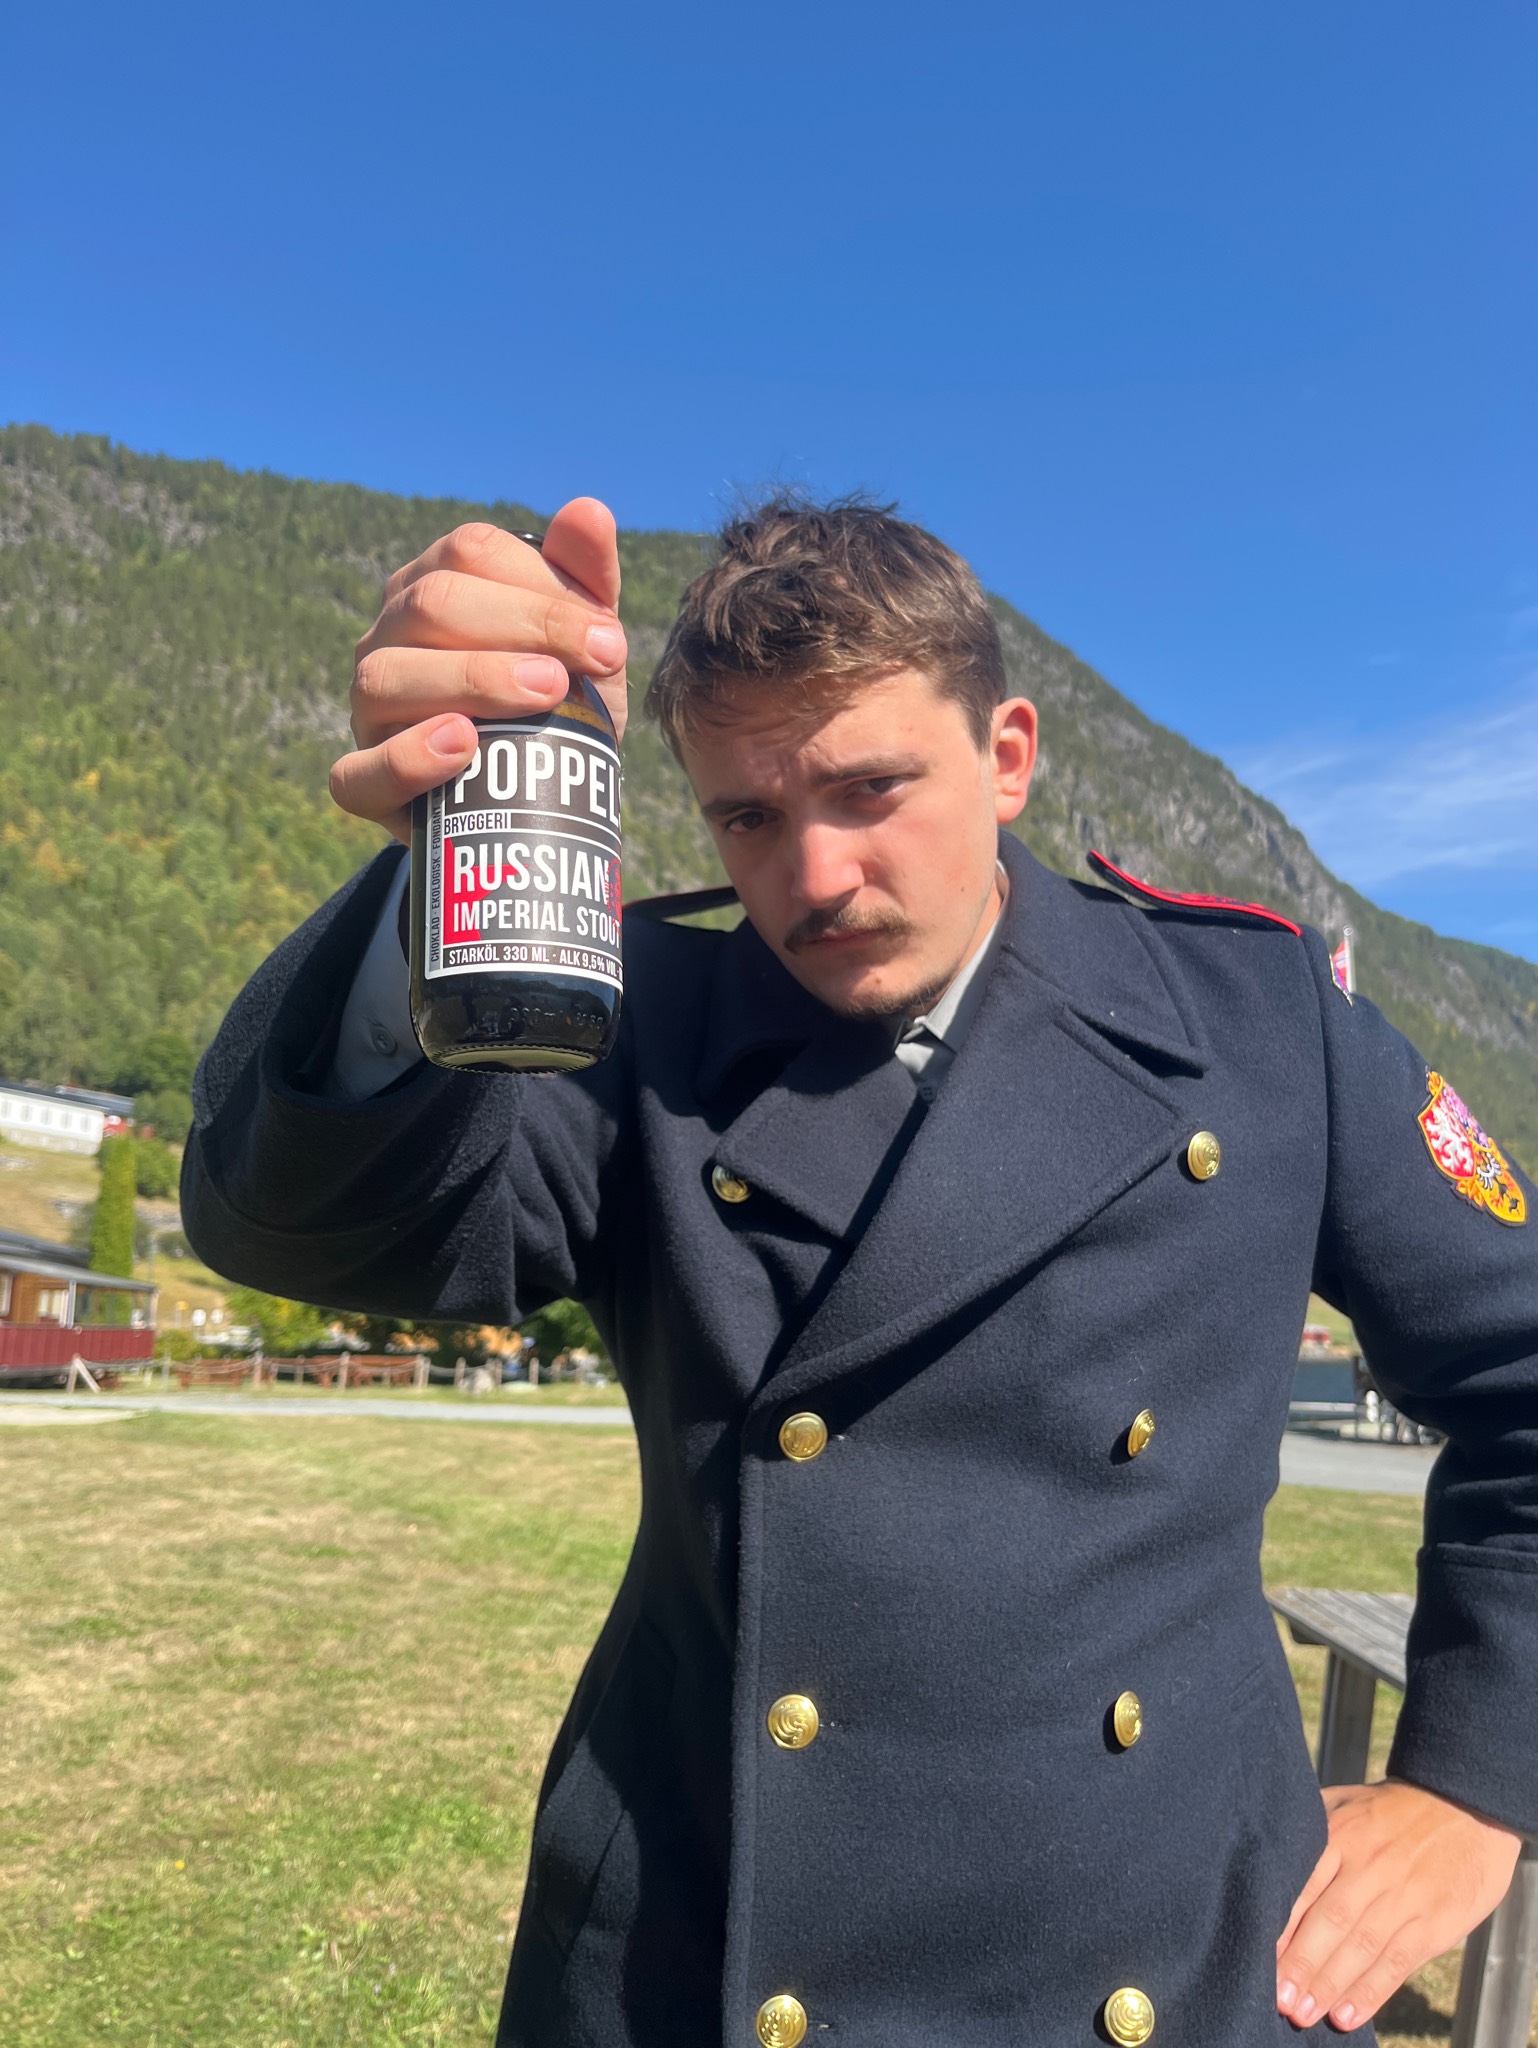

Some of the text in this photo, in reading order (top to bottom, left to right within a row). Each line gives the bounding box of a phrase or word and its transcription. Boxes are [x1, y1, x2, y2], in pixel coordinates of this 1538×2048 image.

[453, 739, 621, 832] POPPEL
[432, 806, 442, 850] FONDANT
[444, 811, 508, 836] BRYGGERI
[432, 857, 441, 910] EKOLOGISK
[453, 842, 609, 905] RUSSIAN
[431, 916, 440, 962] CHOKLAD
[453, 899, 620, 949] IMPERIAL STOUT
[448, 943, 500, 965] STARKÖL
[503, 945, 528, 962] 330
[531, 948, 550, 963] ML
[559, 948, 581, 966] ALK
[582, 952, 605, 972] 9,5%
[606, 958, 618, 977] VOL
